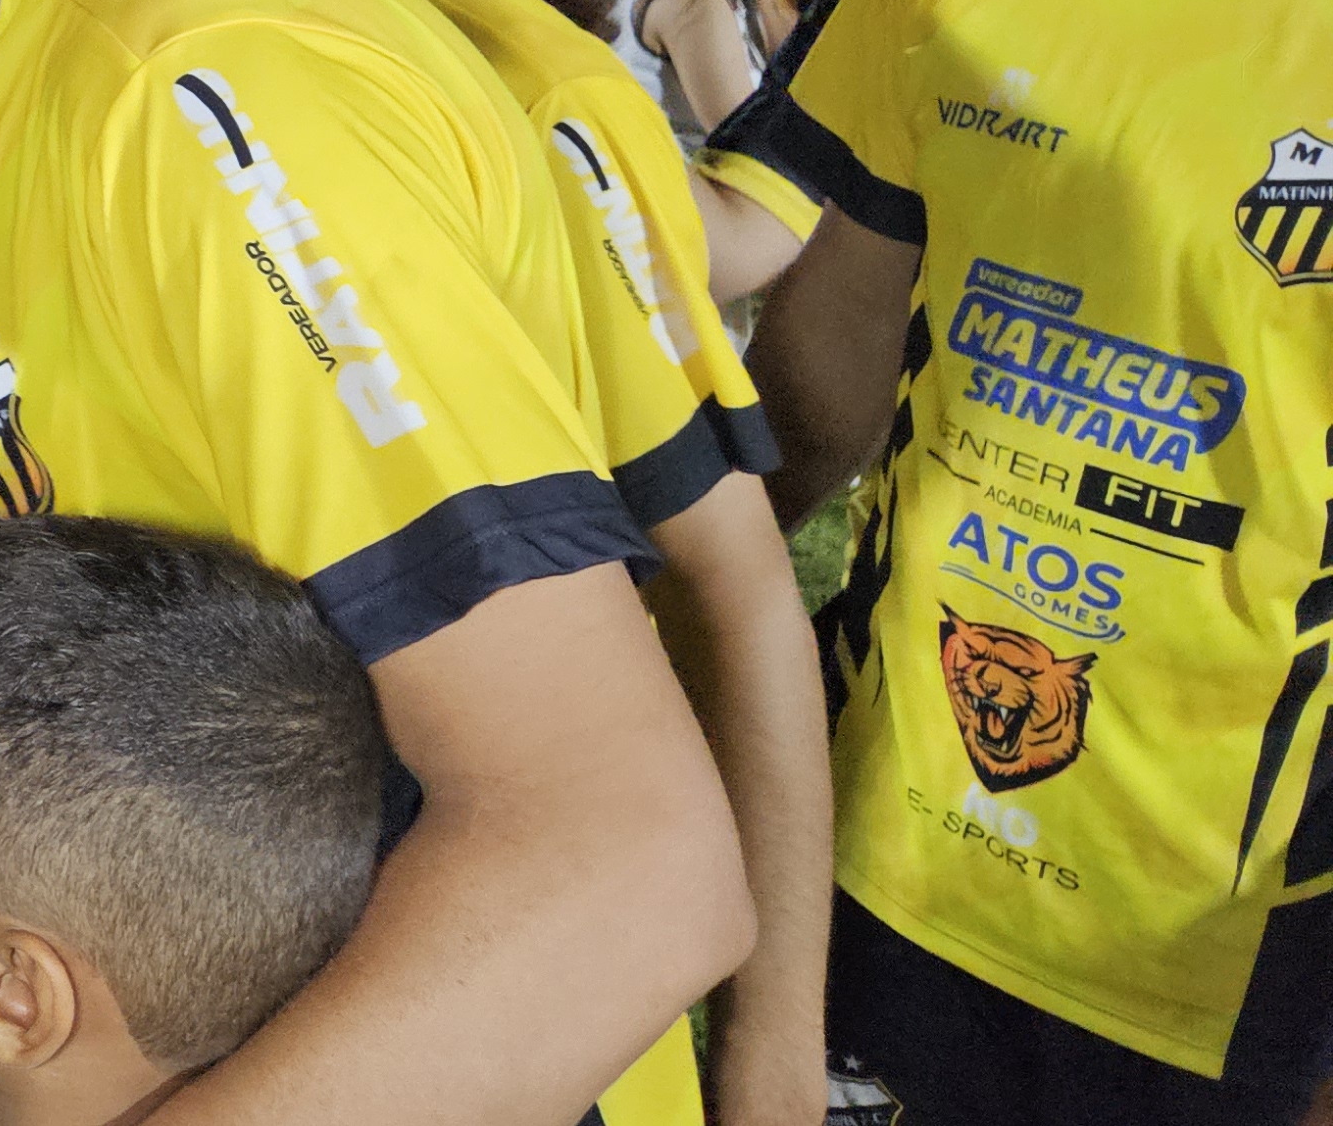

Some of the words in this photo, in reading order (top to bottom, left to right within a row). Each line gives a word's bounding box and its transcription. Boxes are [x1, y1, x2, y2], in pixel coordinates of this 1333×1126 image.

[1259, 185, 1333, 201] MATINH
[1290, 141, 1324, 167] M
[245, 240, 336, 374] VEREADOR
[958, 302, 1231, 423] MATHEUS
[963, 364, 1190, 473] SANTANA
[937, 419, 1071, 494] ENTER
[1105, 476, 1203, 529] FIT
[984, 485, 1083, 535] ACADEMIA
[948, 512, 1125, 610] ATOS
[1014, 582, 1111, 631] GOMES
